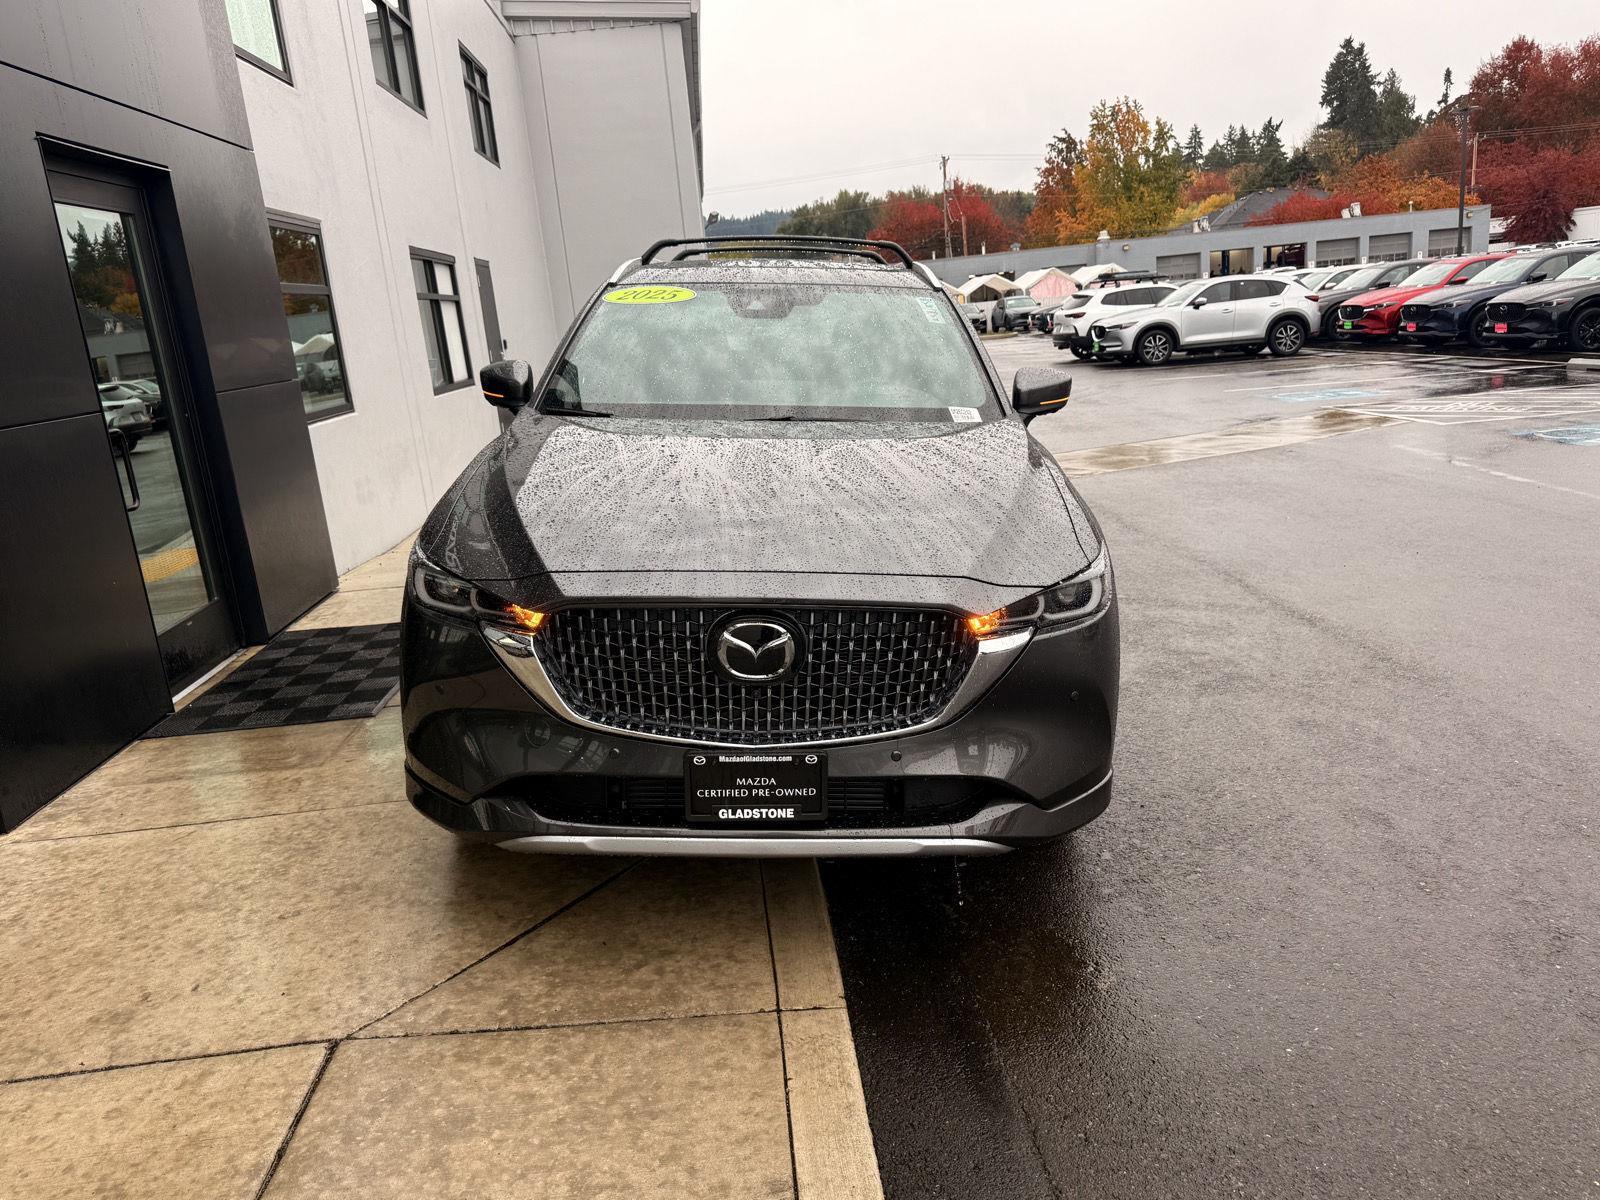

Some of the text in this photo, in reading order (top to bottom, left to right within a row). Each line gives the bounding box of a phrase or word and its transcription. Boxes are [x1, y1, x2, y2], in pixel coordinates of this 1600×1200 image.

[615, 289, 684, 301] 2025
[736, 777, 777, 786] MAZDA
[697, 787, 817, 798] CERTIFIED PRE-OWNED
[718, 808, 795, 819] GLADSTONE
